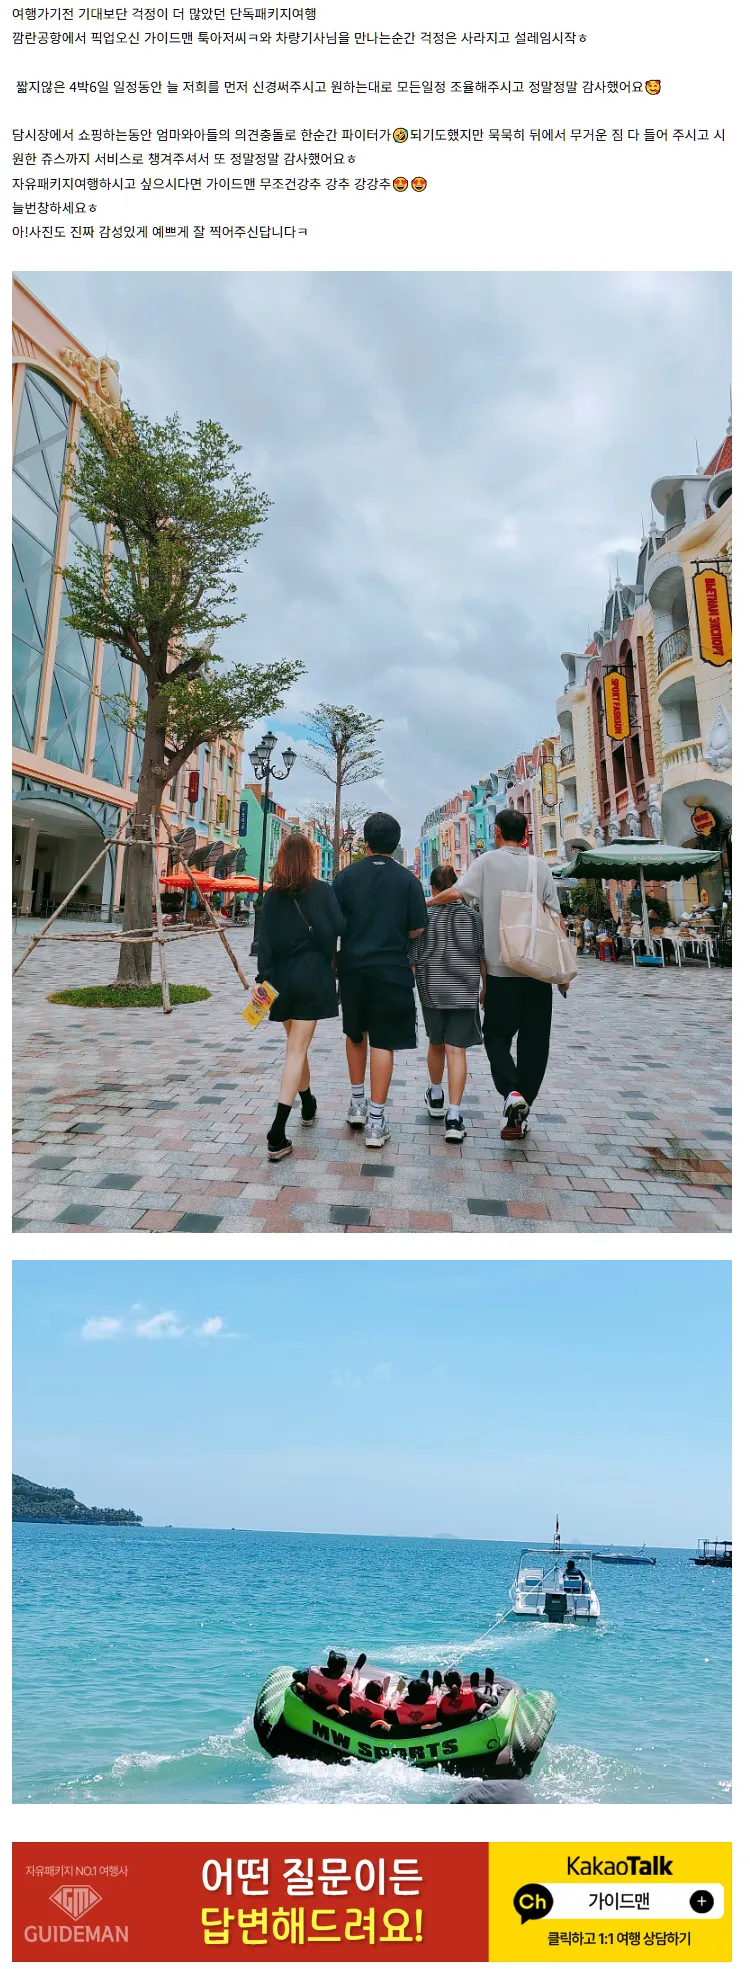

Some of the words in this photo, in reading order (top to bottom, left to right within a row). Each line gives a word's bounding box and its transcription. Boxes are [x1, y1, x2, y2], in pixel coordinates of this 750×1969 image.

[611, 677, 621, 701] SPORT
[613, 702, 623, 735] FASHION
[312, 1719, 351, 1750] MW
[358, 1737, 459, 1761] SPORTS
